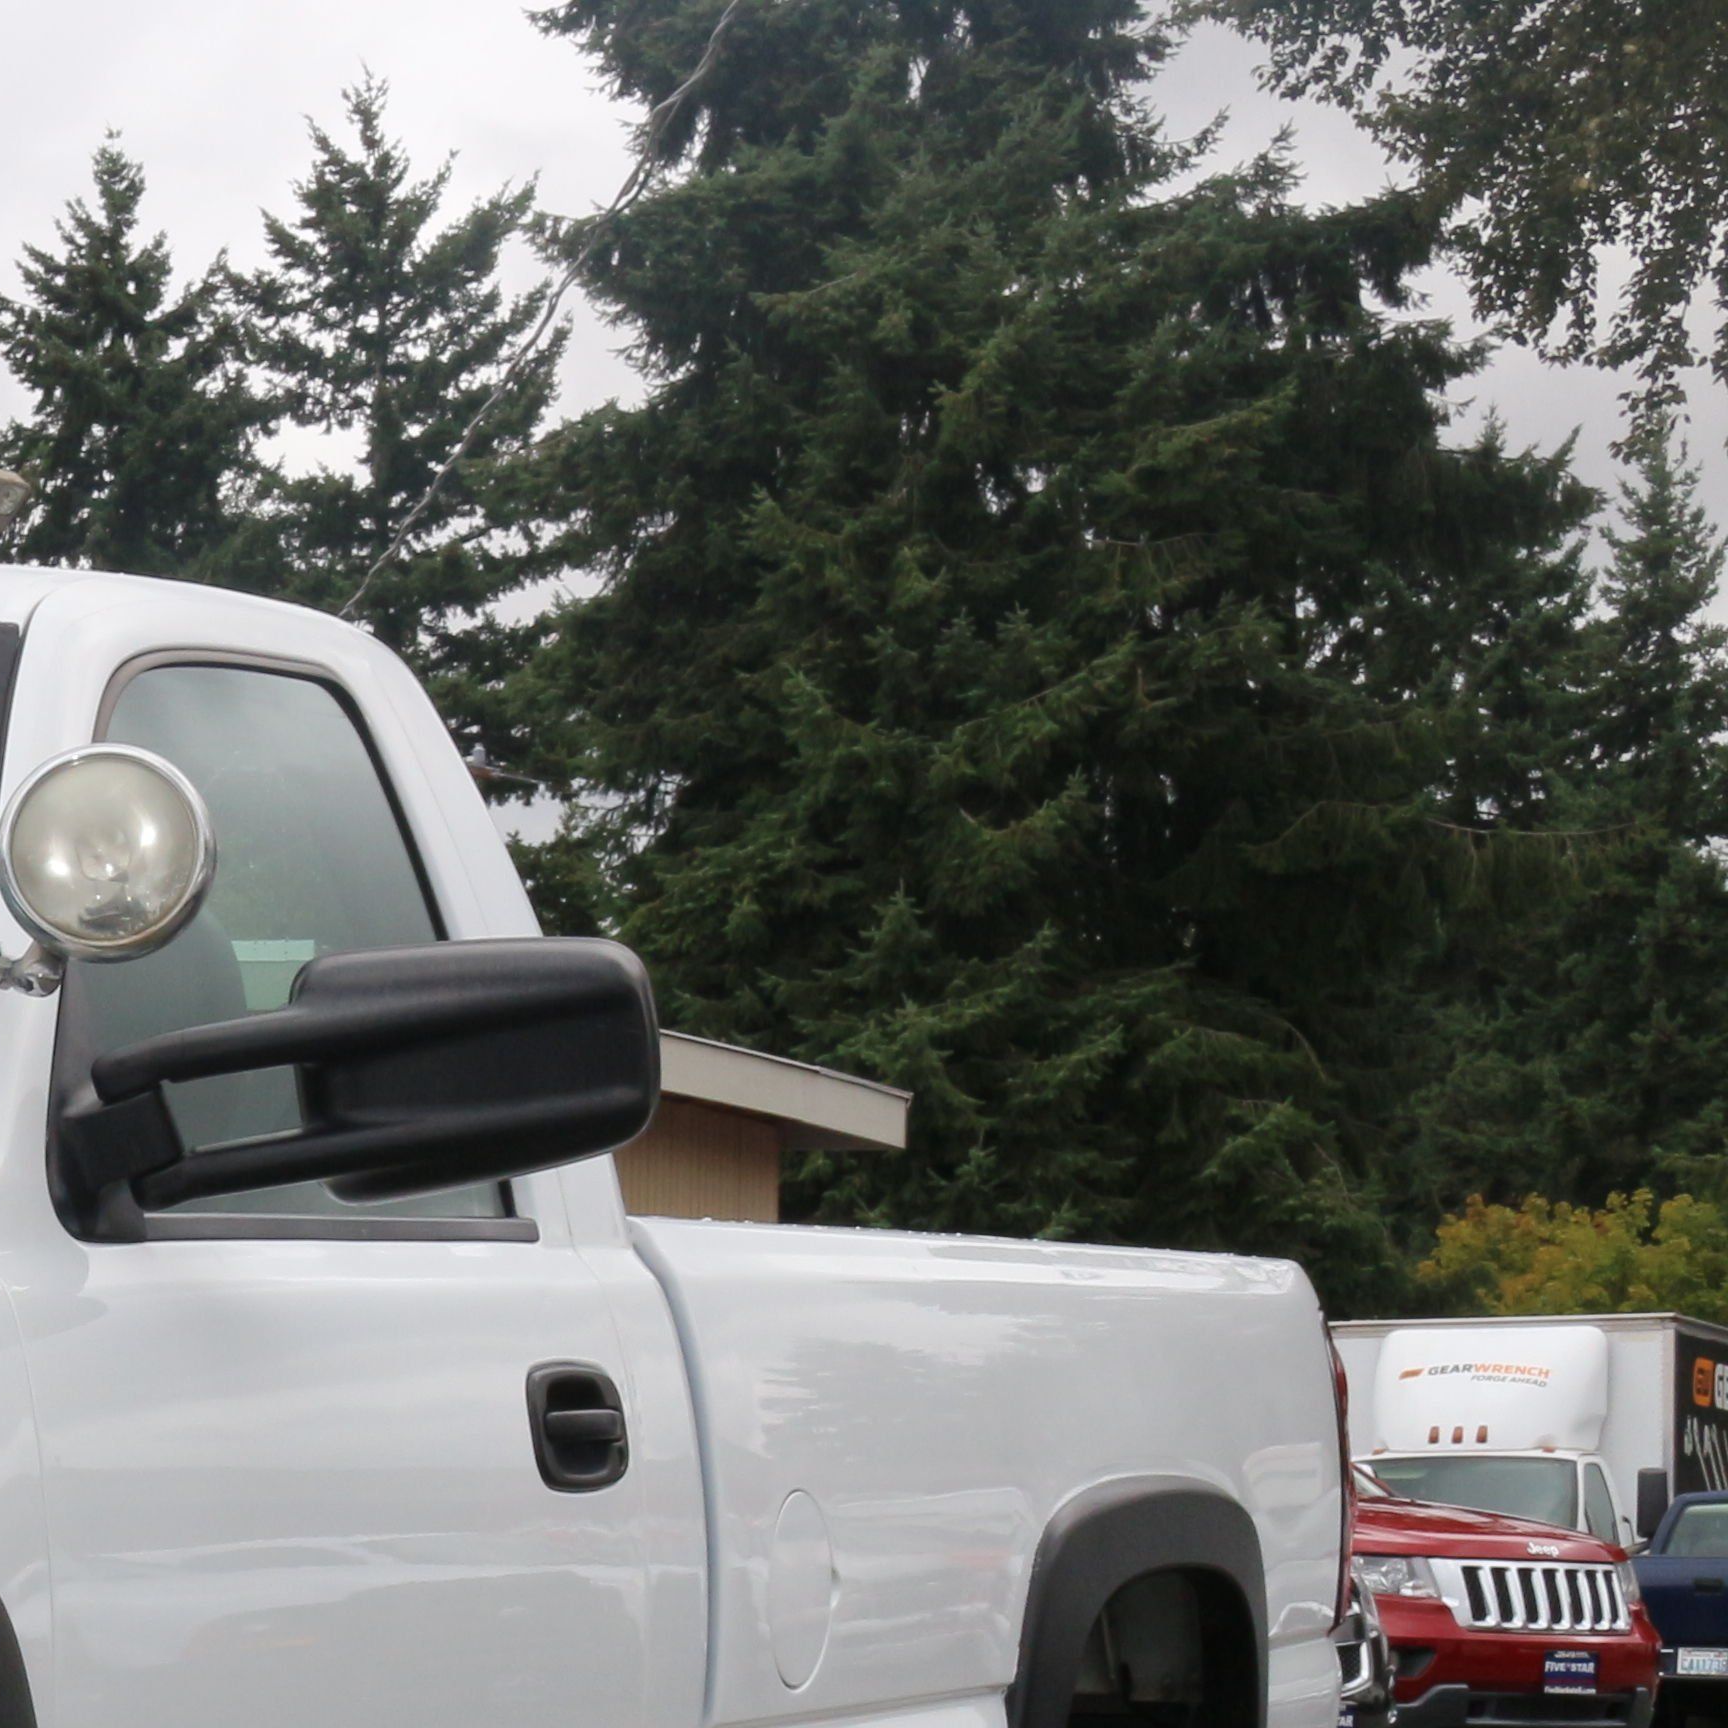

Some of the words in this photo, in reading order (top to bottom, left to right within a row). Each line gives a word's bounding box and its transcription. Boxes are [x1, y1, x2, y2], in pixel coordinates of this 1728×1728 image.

[1427, 1362, 1551, 1379] GEARWRENCH
[1470, 1375, 1506, 1383] FORGE
[1509, 1376, 1548, 1388] AHEAD
[1527, 1541, 1559, 1558] Jeep
